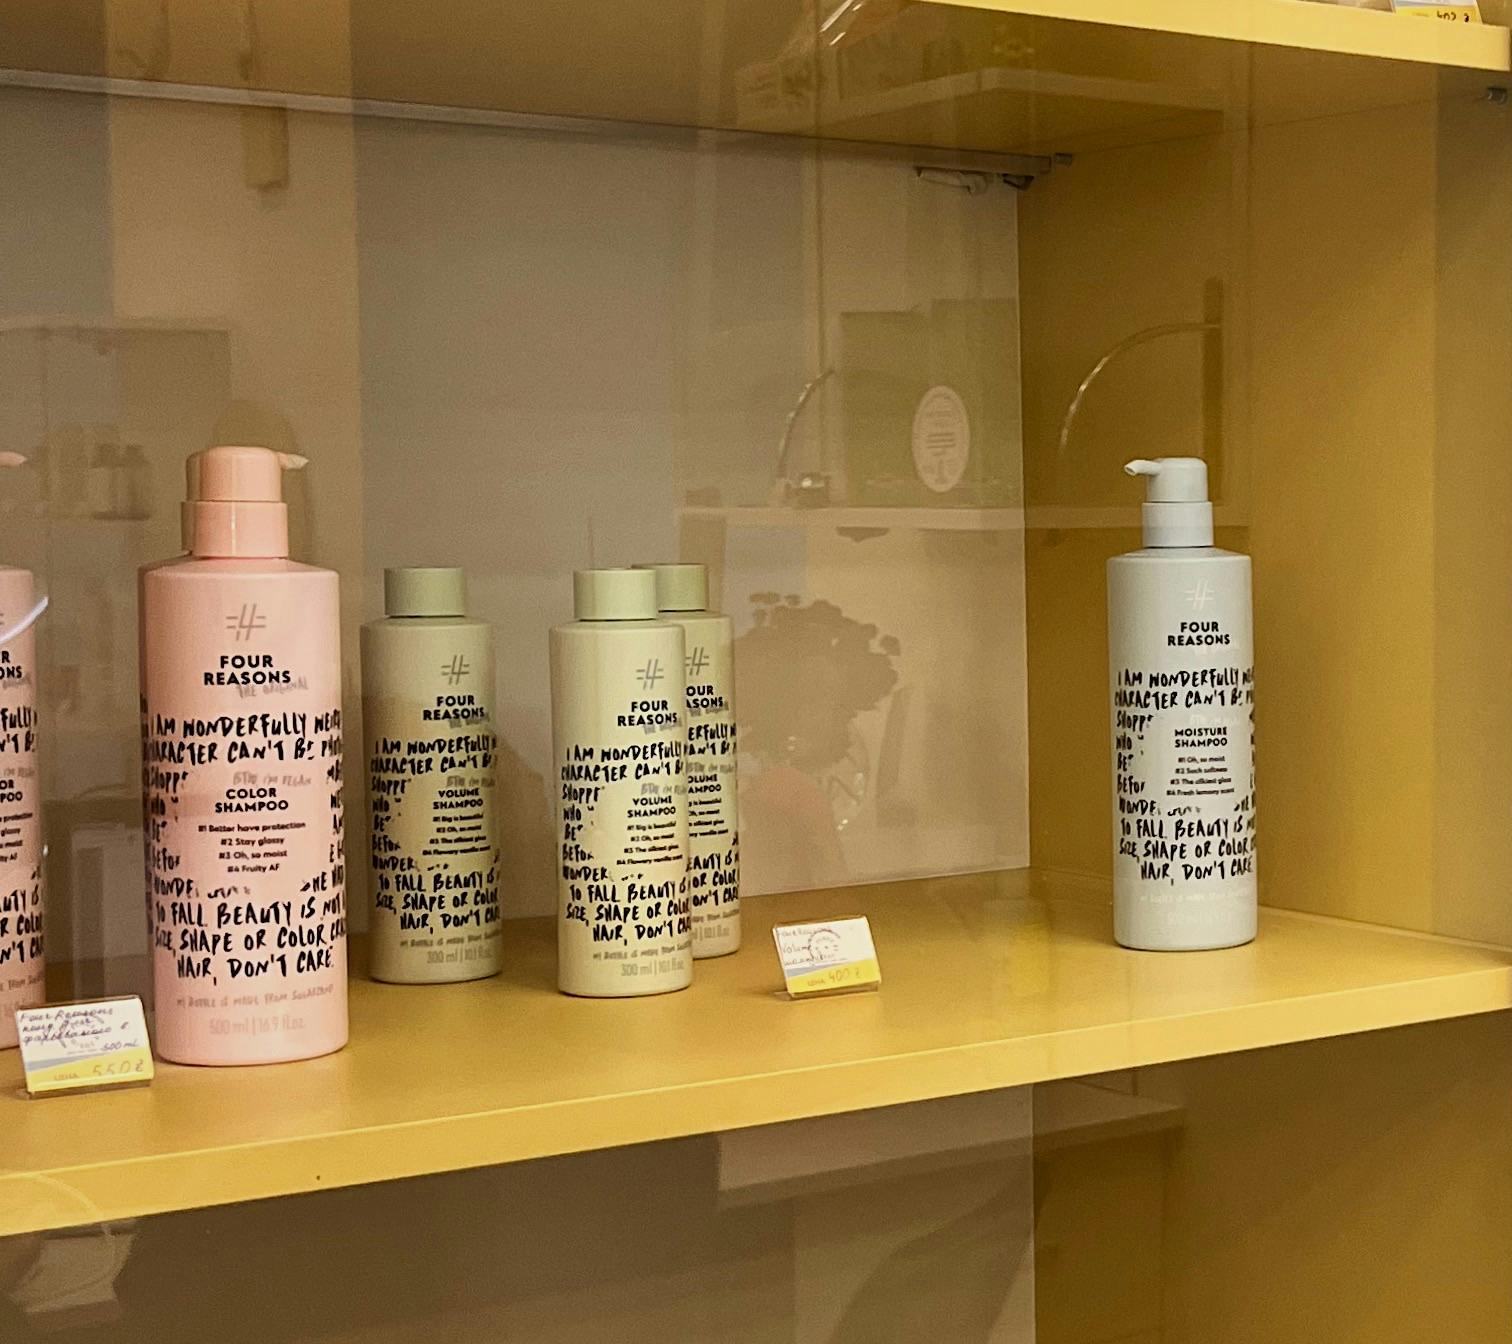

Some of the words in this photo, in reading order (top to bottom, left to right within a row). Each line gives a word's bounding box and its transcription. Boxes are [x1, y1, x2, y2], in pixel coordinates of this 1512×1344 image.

[1180, 621, 1219, 633] FOUR
[1167, 634, 1230, 646] REASONS
[220, 655, 273, 669] FOUR
[203, 670, 291, 686] REASONS
[1125, 668, 1143, 686] AM
[1149, 667, 1239, 688] WONDERFULLY
[686, 685, 714, 697] OUR
[1185, 689, 1225, 708] CAN'T
[436, 695, 475, 707] FOUR
[631, 700, 668, 713] FOUR
[423, 707, 485, 721] REASONS
[617, 713, 678, 727] REASONS
[156, 714, 176, 737] AM
[183, 712, 308, 738] WONDERFULLY
[1174, 727, 1227, 737] MOISTURE
[382, 737, 401, 754] AM
[1174, 737, 1228, 748] SHAMPOO
[227, 739, 284, 764] CAN'T
[574, 744, 594, 762] AM
[440, 755, 478, 773] CAN'T
[635, 761, 671, 780] CAN'T
[688, 774, 718, 784] OLUME
[226, 788, 277, 799] COLOR
[438, 788, 479, 799] VOLUME
[688, 784, 722, 794] AMPOO
[215, 800, 288, 814] SHAMPOO
[432, 799, 484, 810] SHAMPOO
[632, 796, 672, 806] VOLUME
[627, 806, 676, 818] SHAMPOO
[262, 822, 306, 834] protection
[1137, 818, 1165, 839] FALL
[1175, 817, 1229, 841] BEAUTY
[235, 837, 255, 847] Stay
[258, 837, 285, 847] glossy
[1143, 840, 1187, 861] SHAPE
[1195, 840, 1212, 858] OR
[1218, 837, 1249, 856] COLOR
[241, 864, 267, 874] Fruity
[269, 863, 280, 872] AF
[1182, 860, 1225, 880] DON'T
[395, 873, 426, 893] FALL
[433, 870, 483, 893] BEAUTY
[587, 884, 620, 903] FALL
[627, 881, 676, 904] BEAUTY
[402, 893, 446, 912] SHAPE
[452, 891, 468, 907] OR
[171, 902, 204, 927] FALL
[217, 901, 291, 929] BEAUTY
[301, 896, 316, 919] IS
[440, 909, 481, 929] DON'T
[594, 904, 639, 924] SHAPE
[646, 902, 662, 919] OR
[635, 920, 673, 941] DON'T
[180, 928, 233, 956] SHAPE
[244, 929, 266, 950] OR
[277, 924, 327, 949] COLOR
[227, 953, 287, 979] DON'T
